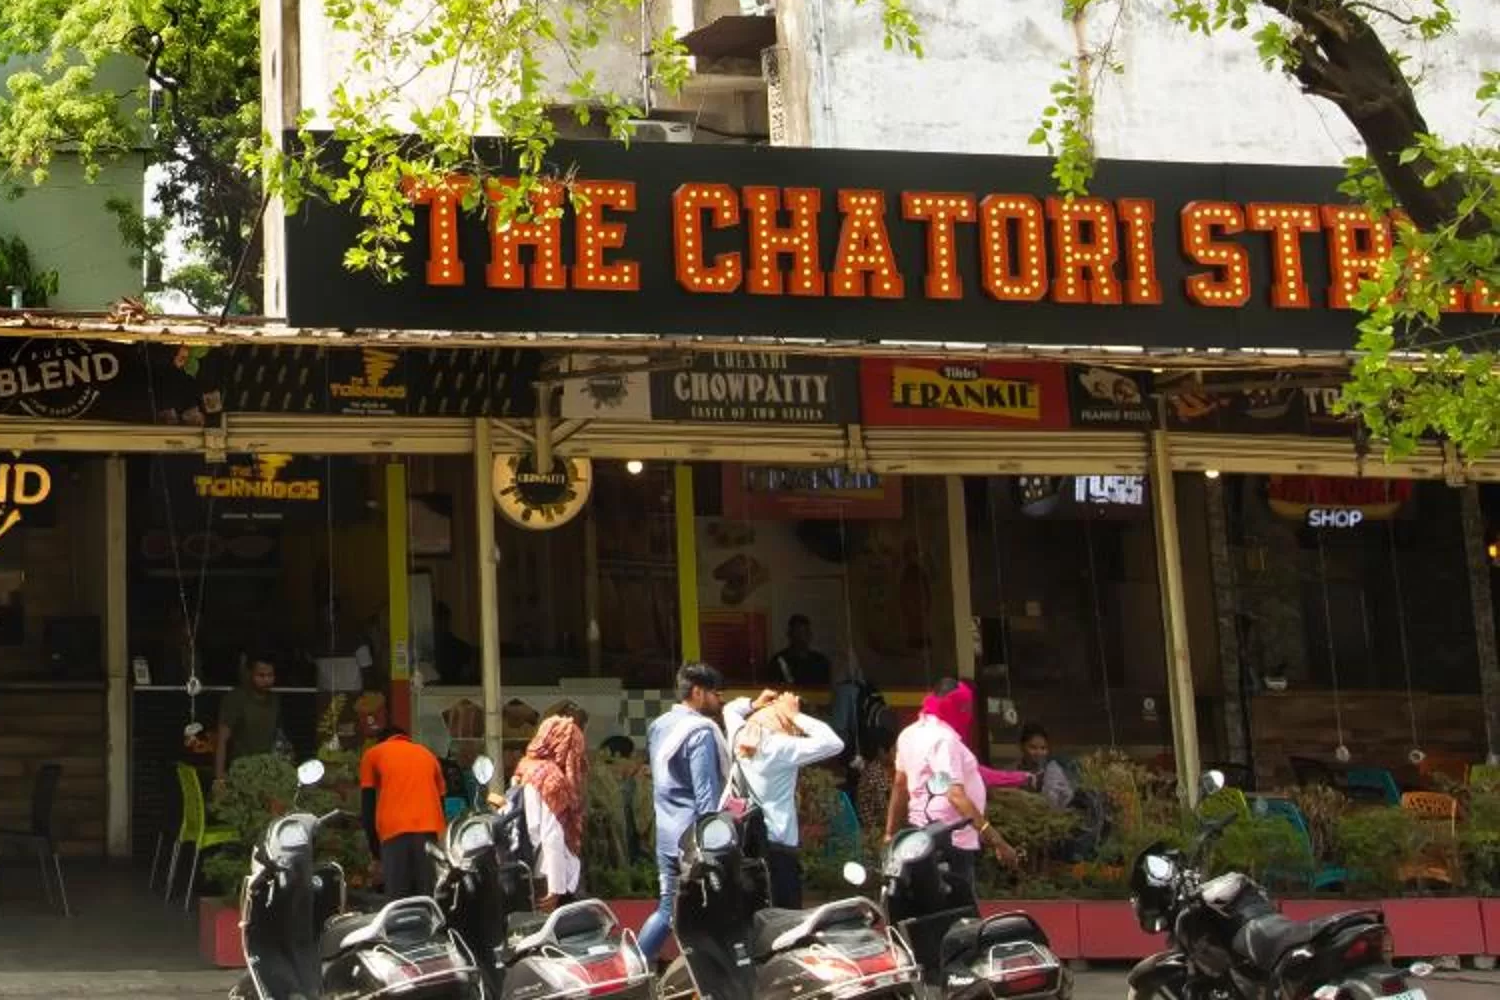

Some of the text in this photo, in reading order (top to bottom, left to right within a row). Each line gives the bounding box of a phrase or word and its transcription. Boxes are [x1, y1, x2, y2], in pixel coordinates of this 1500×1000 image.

[401, 174, 1500, 313] THE CHATORI STR
[944, 365, 979, 380] Tibbs
[674, 372, 829, 403] CHOWPATTY
[898, 381, 1034, 410] FRANKIE
[194, 475, 321, 500] TORNADOS
[1308, 507, 1364, 529] SHOP
